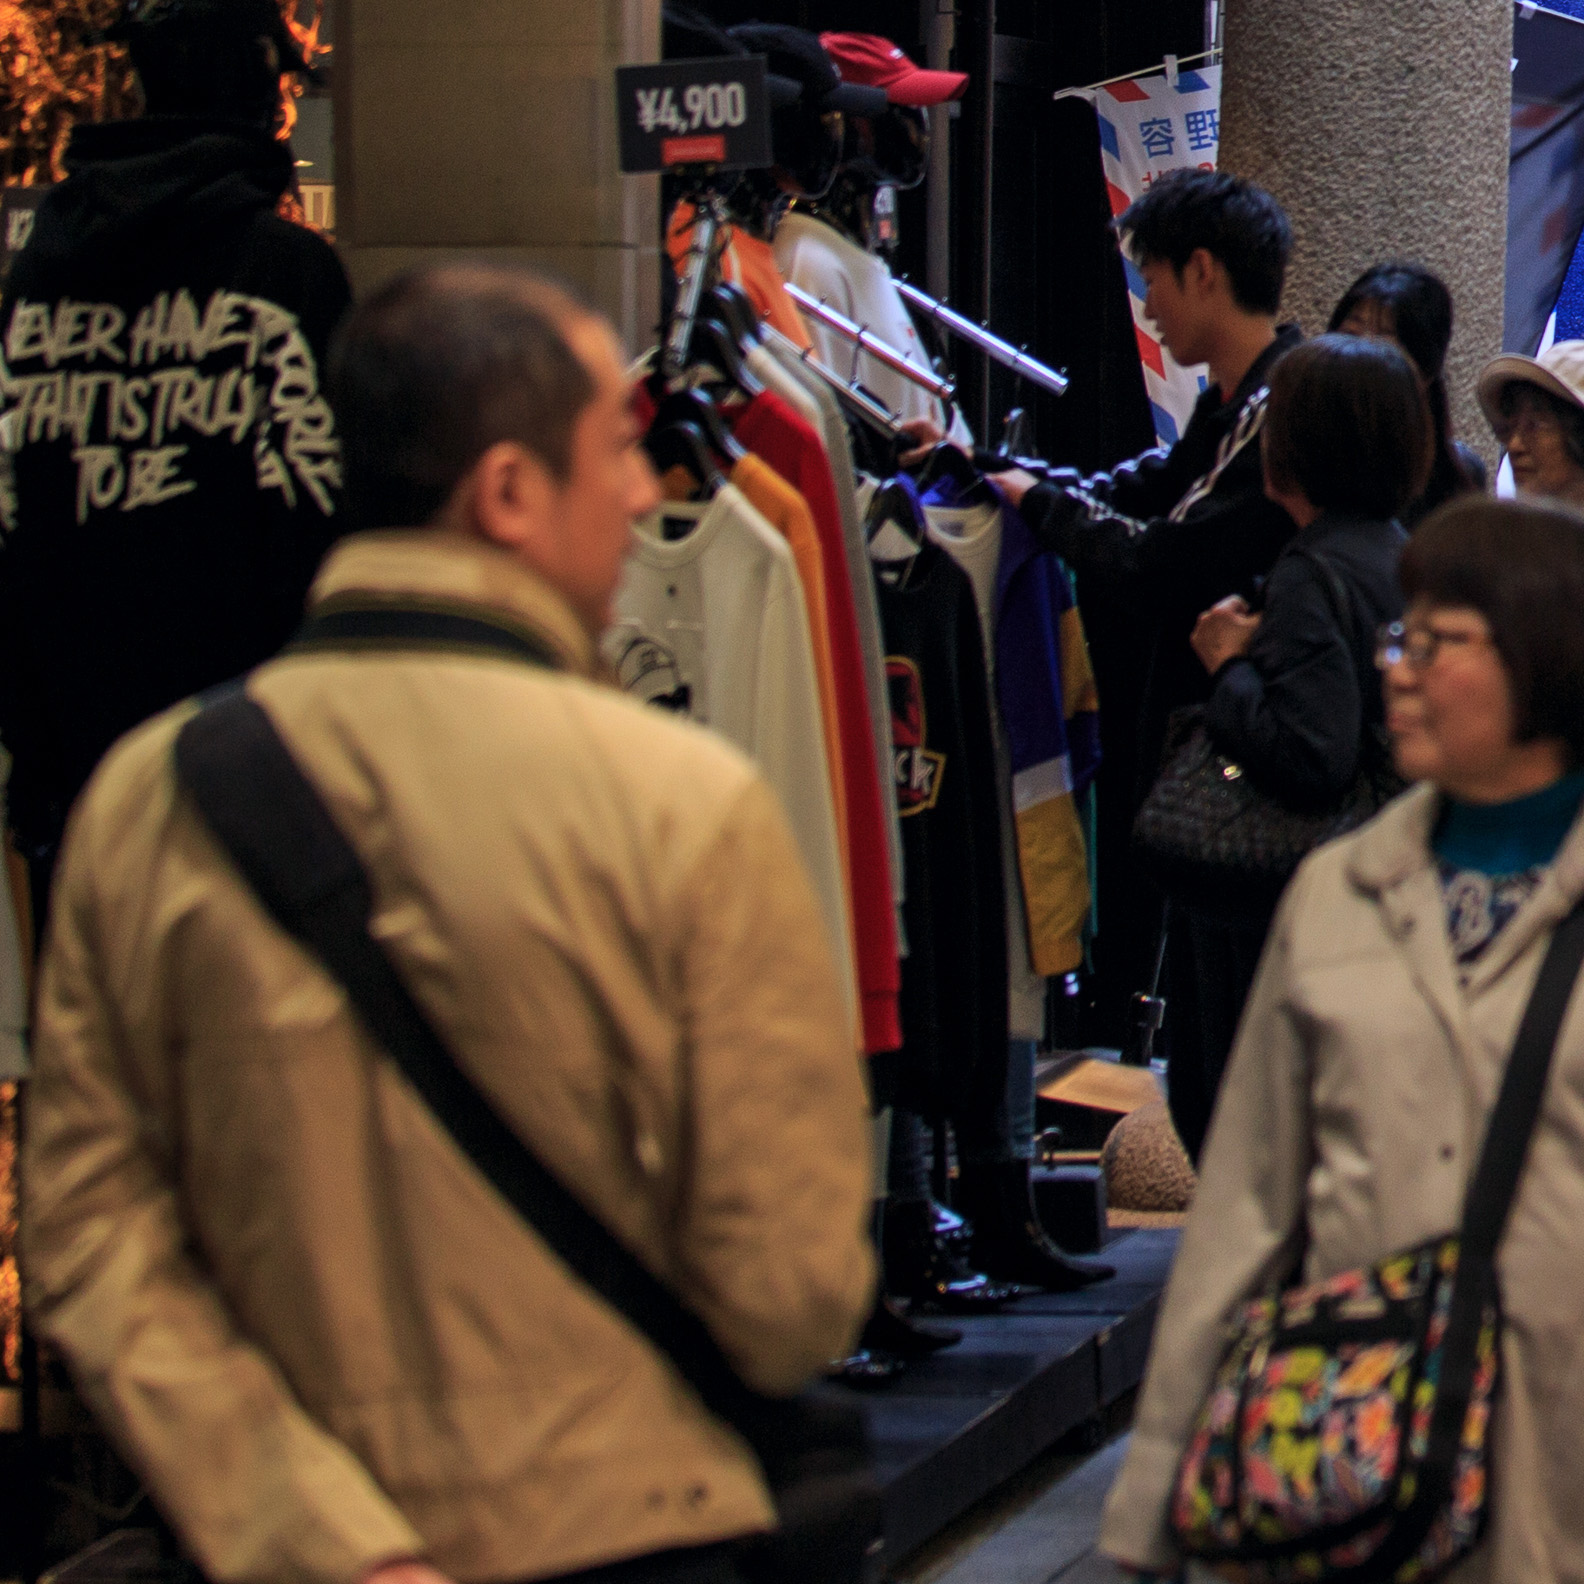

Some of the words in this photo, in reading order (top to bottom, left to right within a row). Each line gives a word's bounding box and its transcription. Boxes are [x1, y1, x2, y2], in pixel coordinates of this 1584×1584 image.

[636, 81, 748, 135] ¥4,900
[71, 443, 125, 526] TO
[119, 443, 198, 512] BE
